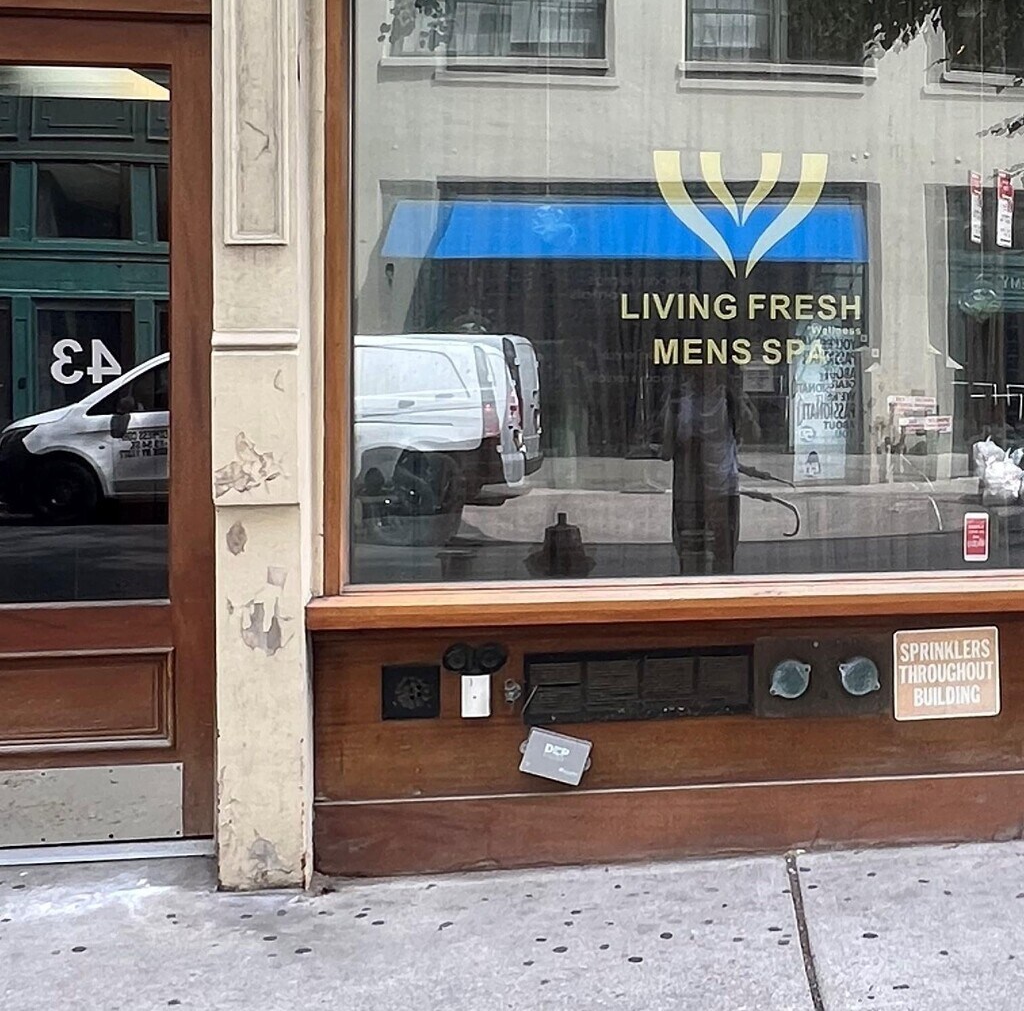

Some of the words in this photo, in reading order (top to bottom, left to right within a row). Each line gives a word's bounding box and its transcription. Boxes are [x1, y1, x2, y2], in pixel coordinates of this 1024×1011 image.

[620, 293, 737, 320] LIVING
[748, 294, 862, 320] FRESH
[653, 338, 752, 365] MENS
[762, 339, 826, 365] SPA
[899, 638, 991, 662] SPRINKLERS
[898, 661, 994, 684] THROUGHOUT
[913, 684, 981, 707] BUILDING
